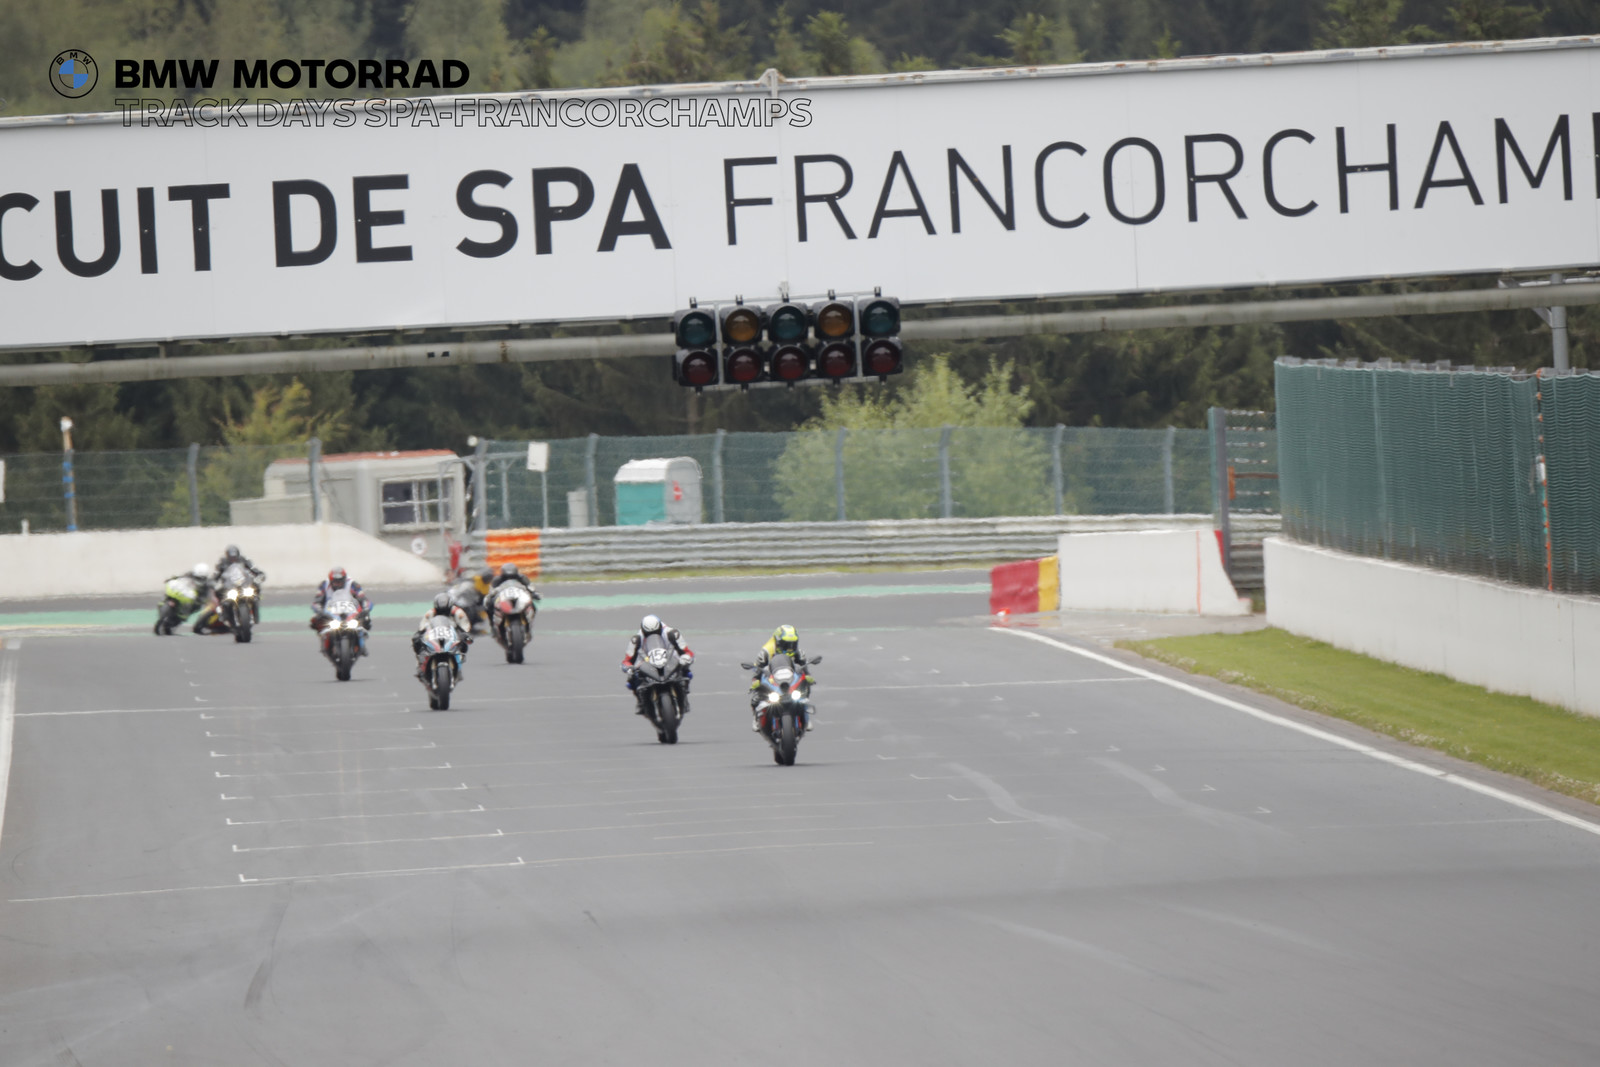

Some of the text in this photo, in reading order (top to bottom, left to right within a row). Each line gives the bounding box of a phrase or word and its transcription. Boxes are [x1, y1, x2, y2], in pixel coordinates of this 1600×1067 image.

[272, 174, 413, 268] DE
[456, 163, 672, 259] SPA
[723, 112, 1600, 246] FRANCORCHAM
